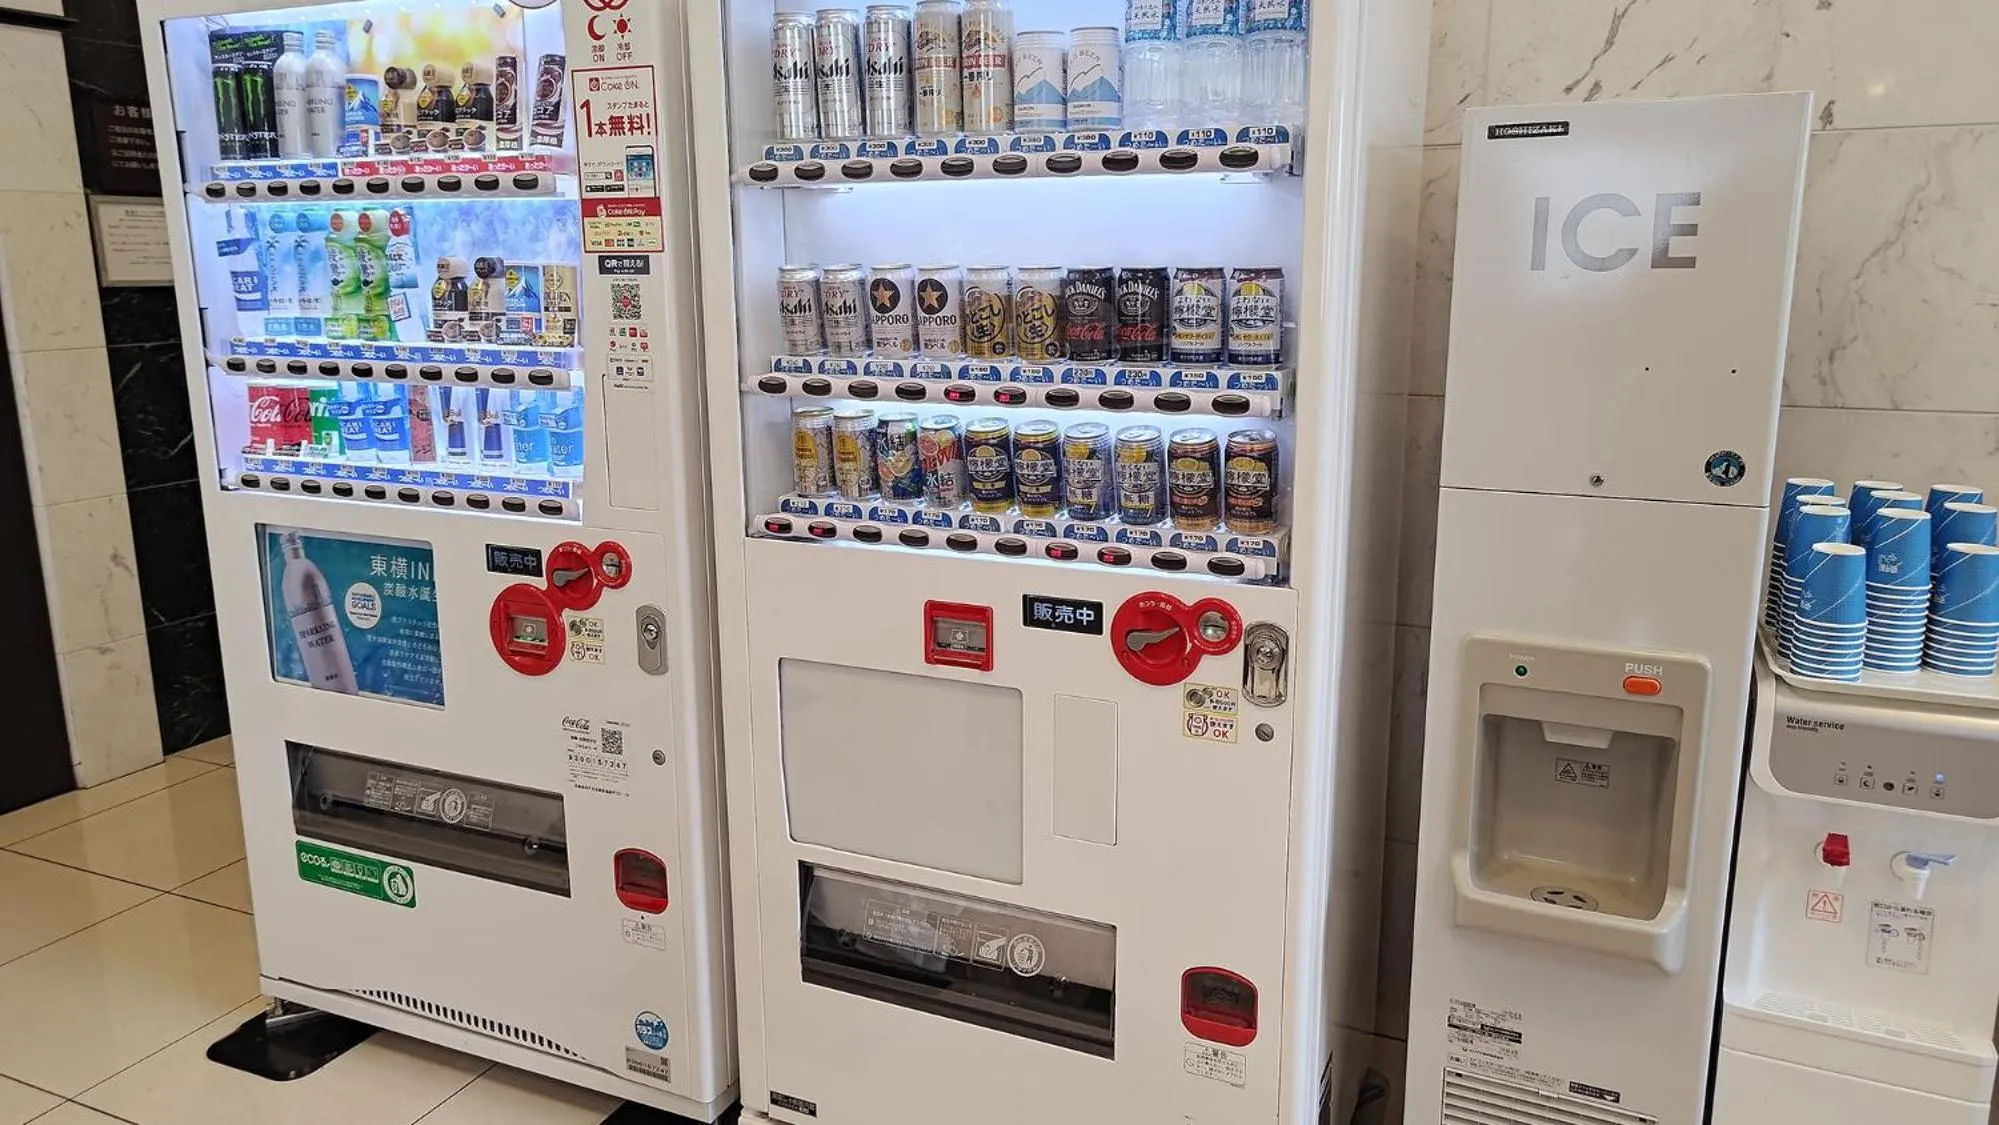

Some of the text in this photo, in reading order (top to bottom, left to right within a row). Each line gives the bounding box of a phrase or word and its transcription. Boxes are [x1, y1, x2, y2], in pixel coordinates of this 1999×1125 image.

[592, 54, 604, 62] ON
[616, 52, 632, 60] OFF
[601, 82, 622, 91] Coke
[1495, 124, 1565, 136] HOSHIZAKI
[1530, 191, 1702, 272] ICE
[872, 314, 910, 326] APPORO
[918, 315, 958, 326] APPORO
[493, 551, 537, 570] 販売中
[370, 555, 430, 580] 東横IN
[1032, 602, 1095, 626] 販売中
[307, 636, 334, 649] WATER
[1625, 662, 1663, 676] PUSH
[1216, 690, 1230, 699] OK
[1786, 714, 1845, 731] Water service
[1213, 728, 1229, 739] OK
